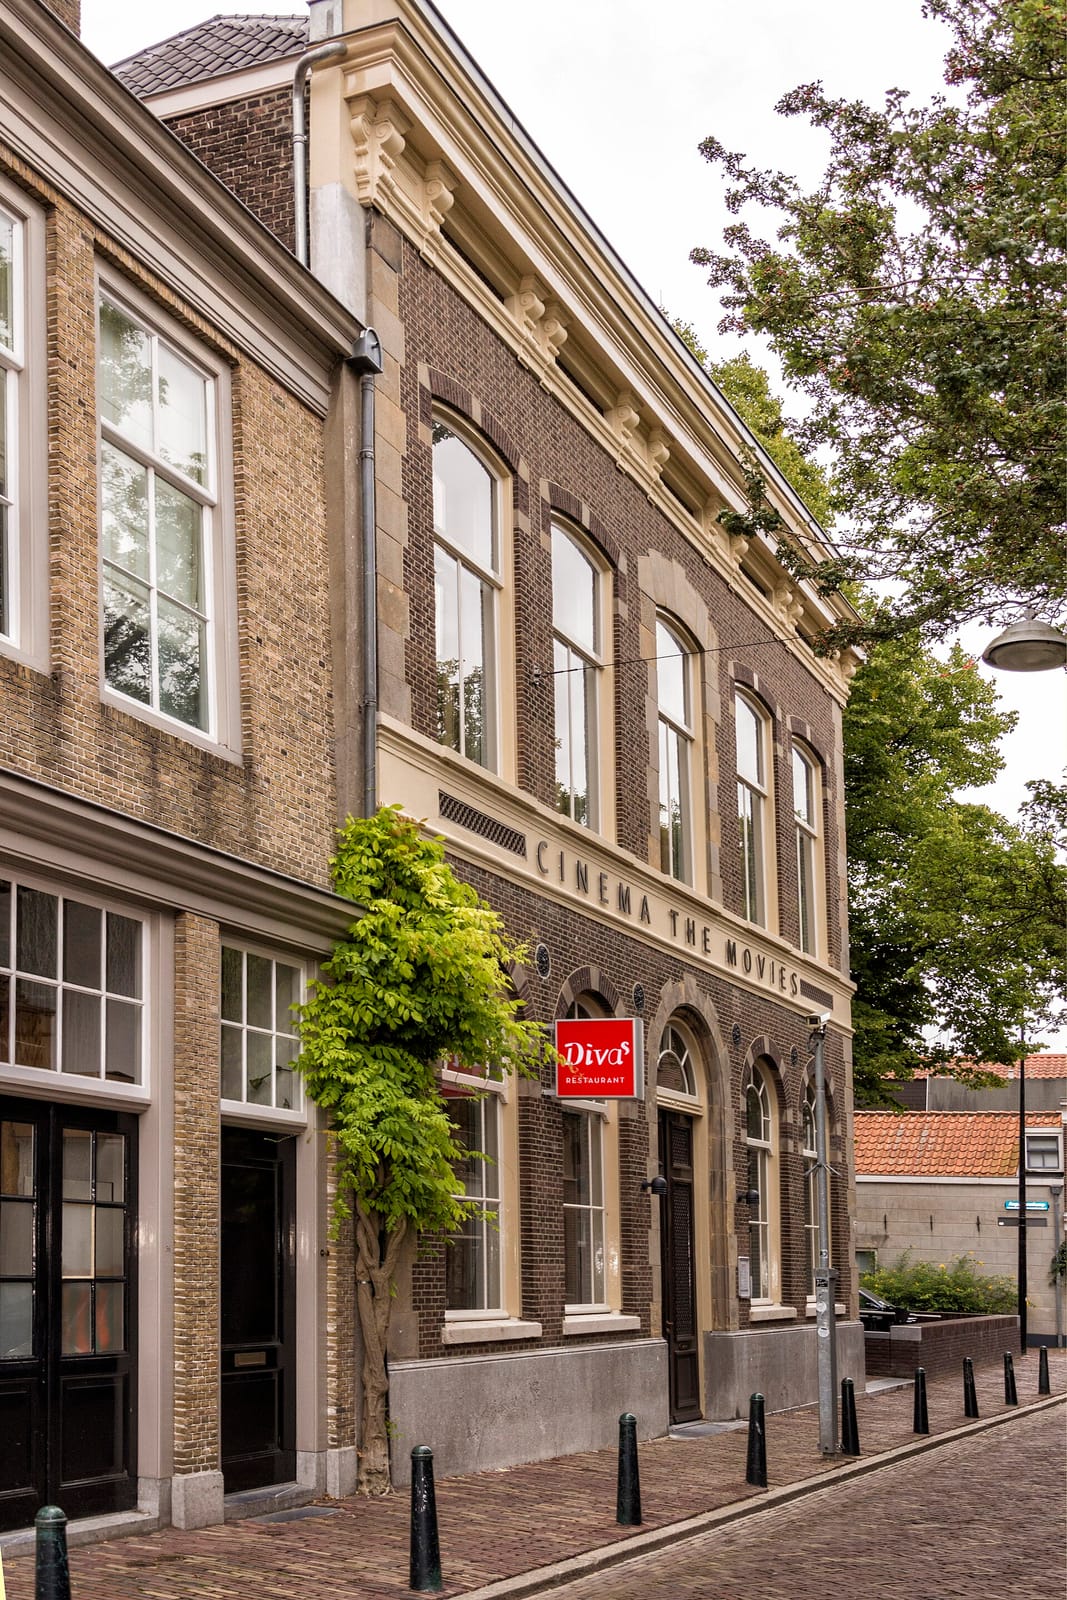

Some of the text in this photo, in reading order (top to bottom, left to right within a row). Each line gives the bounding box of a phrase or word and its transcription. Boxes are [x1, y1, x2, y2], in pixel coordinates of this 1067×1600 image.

[537, 840, 798, 996] CINEMA THE MOVIES
[564, 1041, 630, 1066] Divas
[565, 1076, 625, 1084] RESTAURANT
